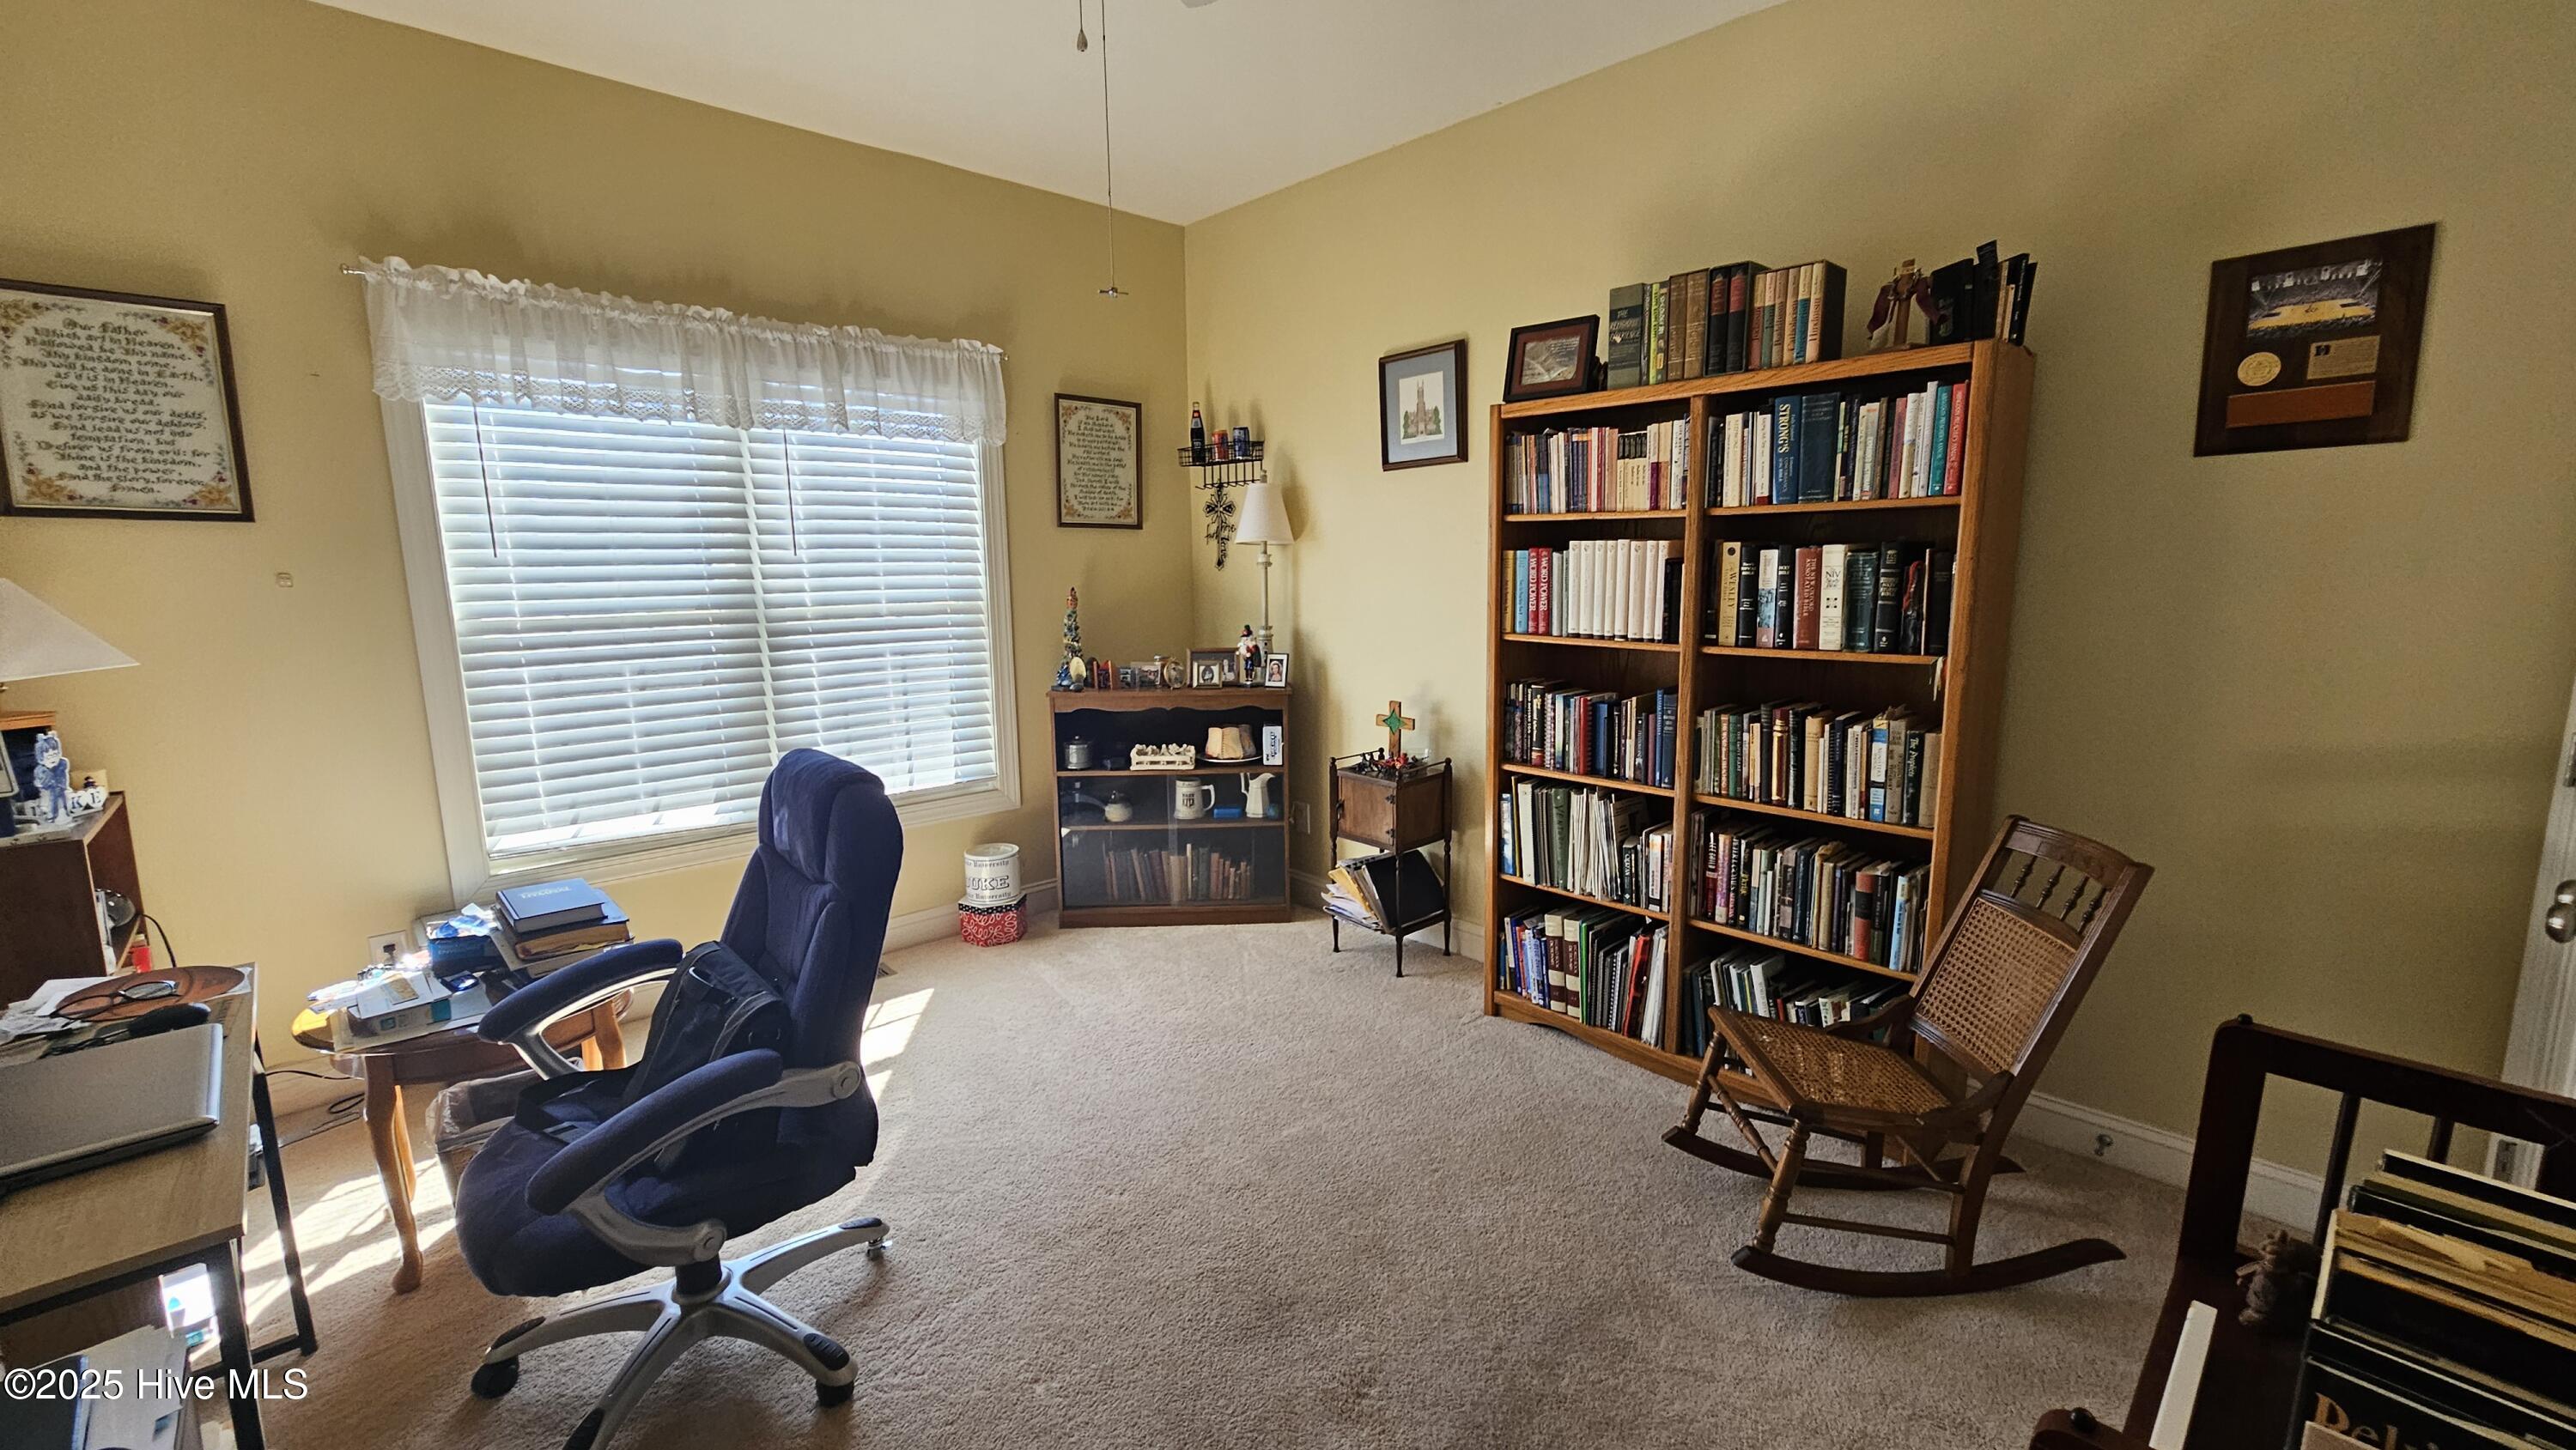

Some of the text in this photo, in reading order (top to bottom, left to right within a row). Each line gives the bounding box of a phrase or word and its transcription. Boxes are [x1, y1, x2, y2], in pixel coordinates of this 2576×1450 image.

[99, 322, 147, 336] Father
[1752, 306, 1761, 342] Judaism
[1774, 301, 1783, 346] Buddhism
[1787, 300, 1798, 351] Catholicism
[1809, 298, 1820, 342] Hinduism
[80, 362, 98, 373] be
[82, 383, 99, 391] us
[102, 385, 129, 395] this
[123, 426, 141, 435] us
[1778, 403, 1791, 453] STRONG'S
[115, 455, 137, 464] the
[119, 446, 155, 456] from
[107, 464, 130, 474] the
[1540, 557, 1549, 611] WORD POWER
[1727, 573, 1737, 609] WESLEY
[1907, 737, 1920, 778] The Prophets
[967, 876, 1009, 891] UKE
